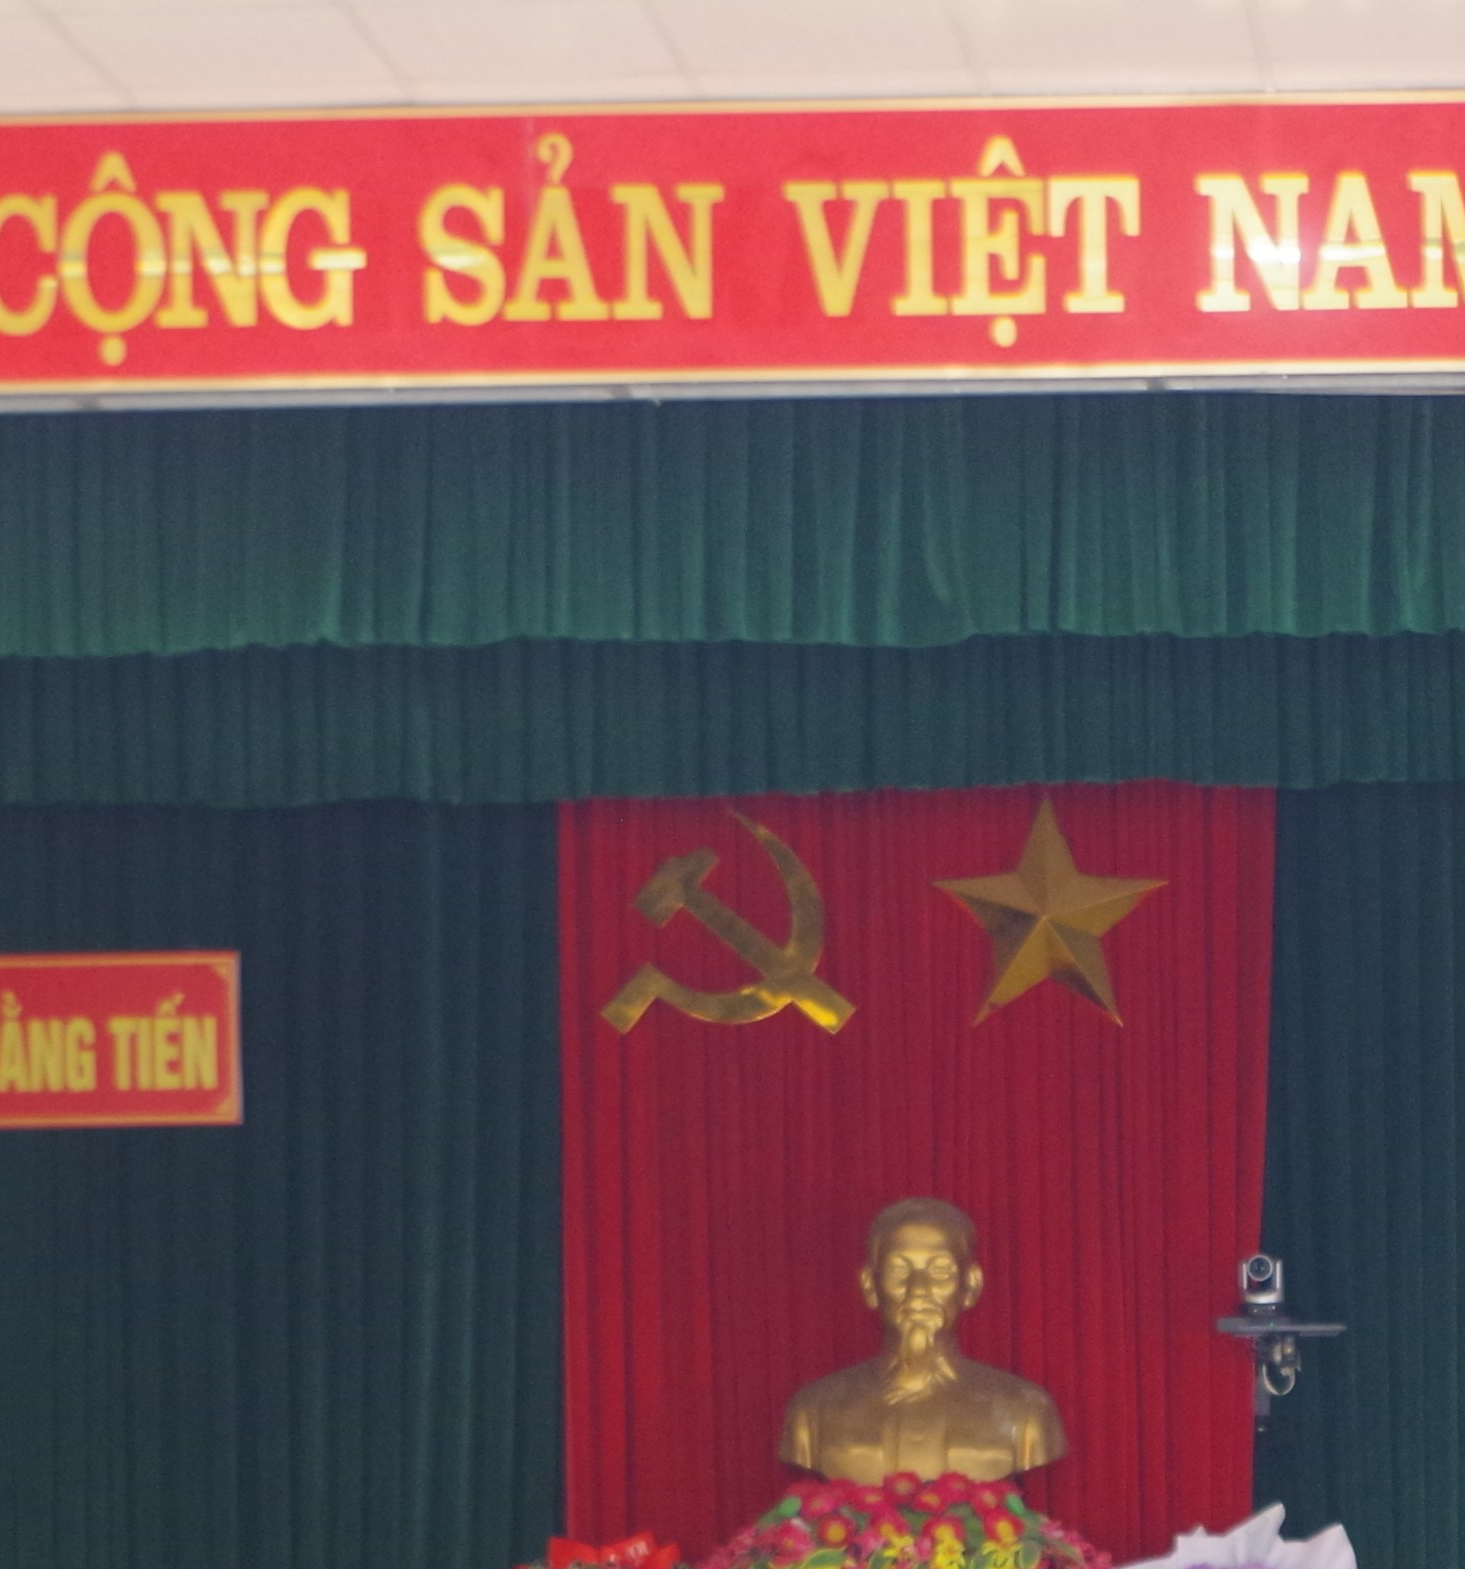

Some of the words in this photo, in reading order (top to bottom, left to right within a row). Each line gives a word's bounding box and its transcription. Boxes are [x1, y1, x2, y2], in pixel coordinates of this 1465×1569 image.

[418, 133, 725, 327] SẢN
[784, 134, 1141, 348] VIỆT
[107, 991, 218, 1091] TIẾN
